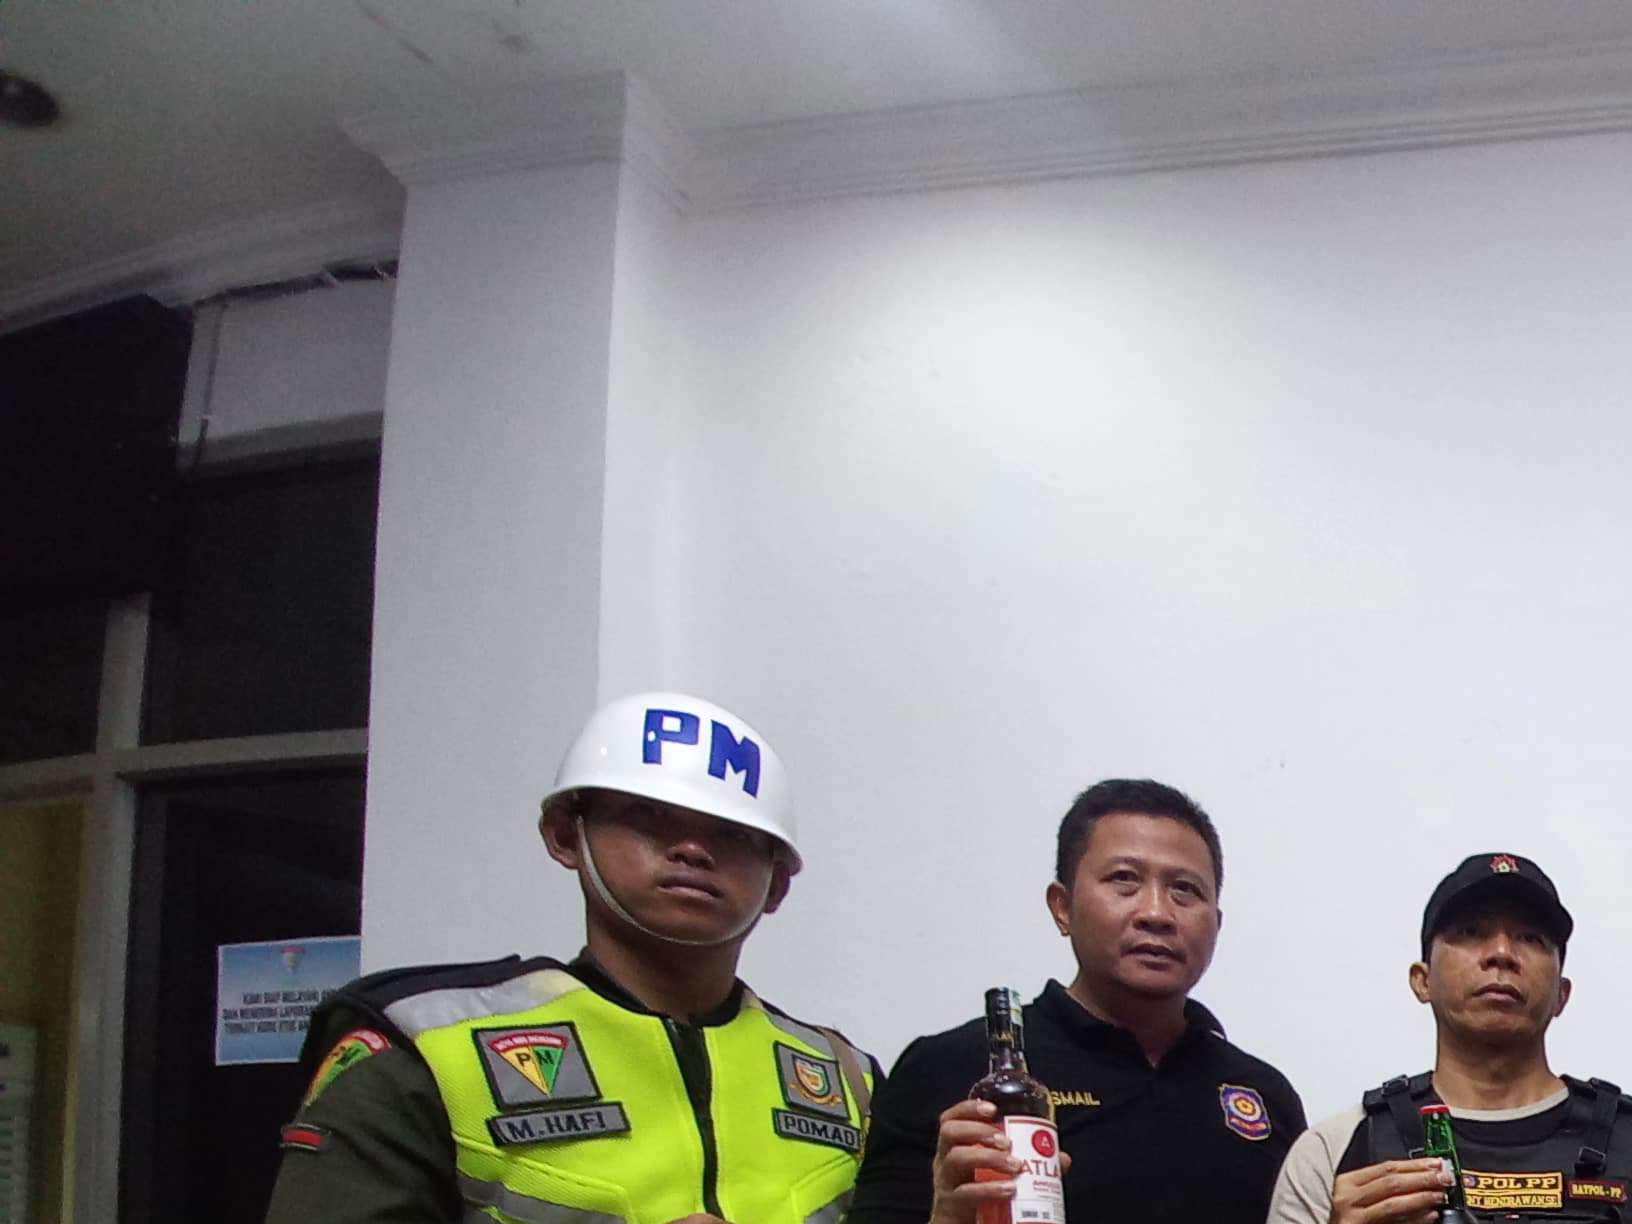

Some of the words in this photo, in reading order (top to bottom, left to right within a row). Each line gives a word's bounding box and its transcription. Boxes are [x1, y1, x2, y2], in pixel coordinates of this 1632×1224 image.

[642, 708, 761, 799] PM
[515, 1050, 556, 1068] PM
[784, 1115, 855, 1146] POMAD
[1477, 1178, 1521, 1188] POL
[1525, 1178, 1556, 1188] PP
